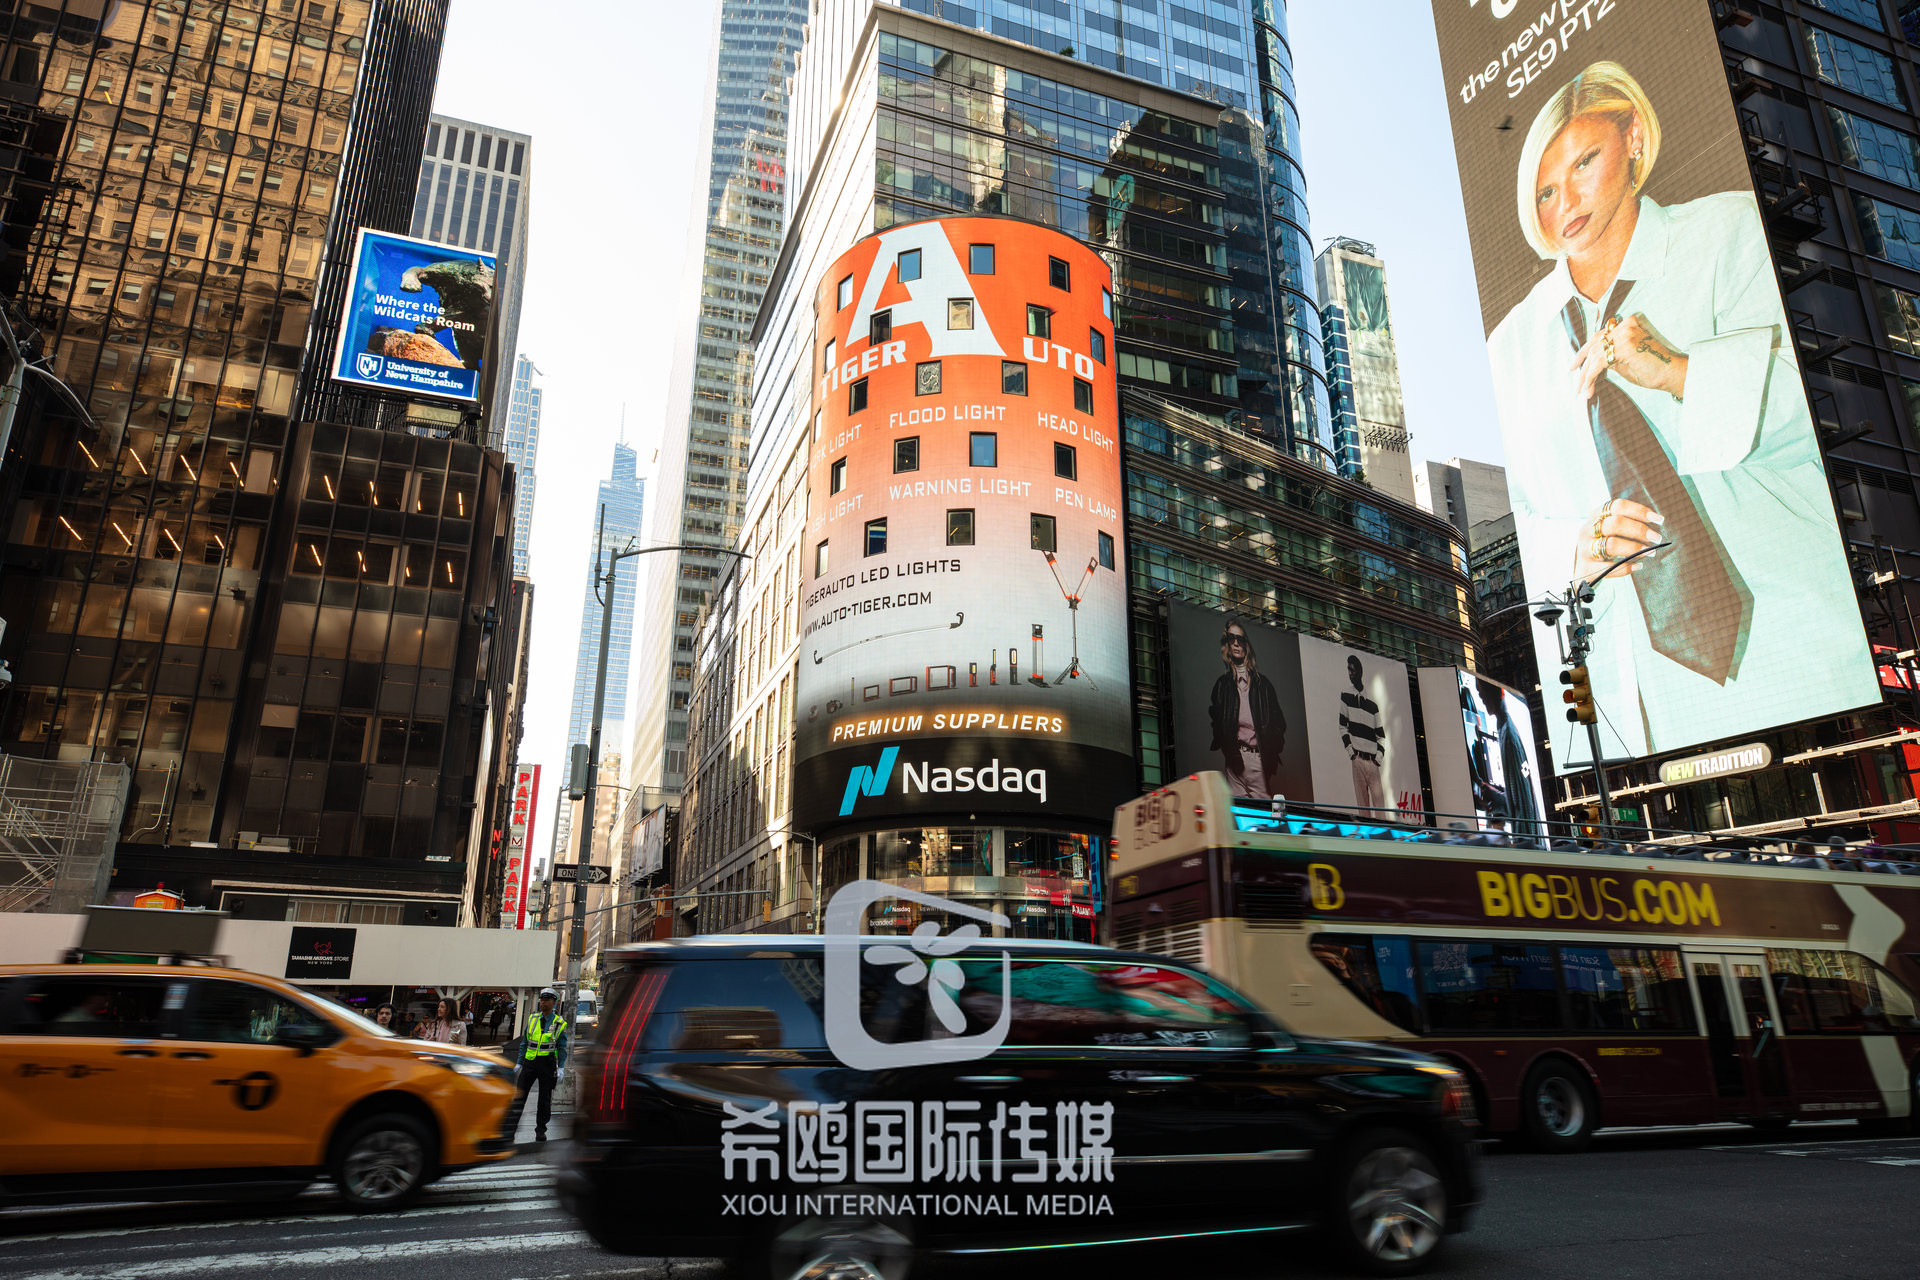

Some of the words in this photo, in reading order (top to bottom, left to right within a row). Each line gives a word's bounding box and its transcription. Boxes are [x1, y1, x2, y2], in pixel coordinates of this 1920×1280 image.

[1459, 60, 1500, 104] the
[1501, 1, 1557, 69] new
[1506, 37, 1557, 99] SE9
[373, 305, 433, 324] Wildcats
[436, 316, 475, 332] Roam
[375, 293, 420, 310] Where
[422, 302, 446, 315] the
[384, 369, 409, 381] New
[410, 373, 464, 390] Hampshire
[386, 361, 437, 378] University
[438, 370, 449, 378] of
[820, 340, 907, 401] TIGER
[889, 406, 946, 429] FLOOD
[953, 404, 1007, 421] LIGHT
[829, 424, 862, 454] LIGHT
[1037, 411, 1078, 437] HEAD
[1082, 426, 1114, 455] LIGHT
[889, 478, 972, 501] WARNING
[980, 478, 1032, 497] LIGHT
[1055, 487, 1083, 509] PEN
[1088, 497, 1118, 523] LAMP
[829, 493, 864, 524] LIGHT
[805, 574, 855, 612] TIGERAUTO
[861, 566, 889, 584] LED
[897, 559, 961, 577] LIGHTS
[833, 715, 923, 742] PREMIUM
[933, 712, 1063, 733] SUPPLIERS
[902, 758, 1047, 803] Nasdaq
[513, 772, 531, 825] PARK
[503, 857, 521, 913] PARK
[588, 871, 602, 879] AY
[1026, 906, 1047, 914] Nasdaq
[1476, 870, 1722, 927] BIGBUS.COM
